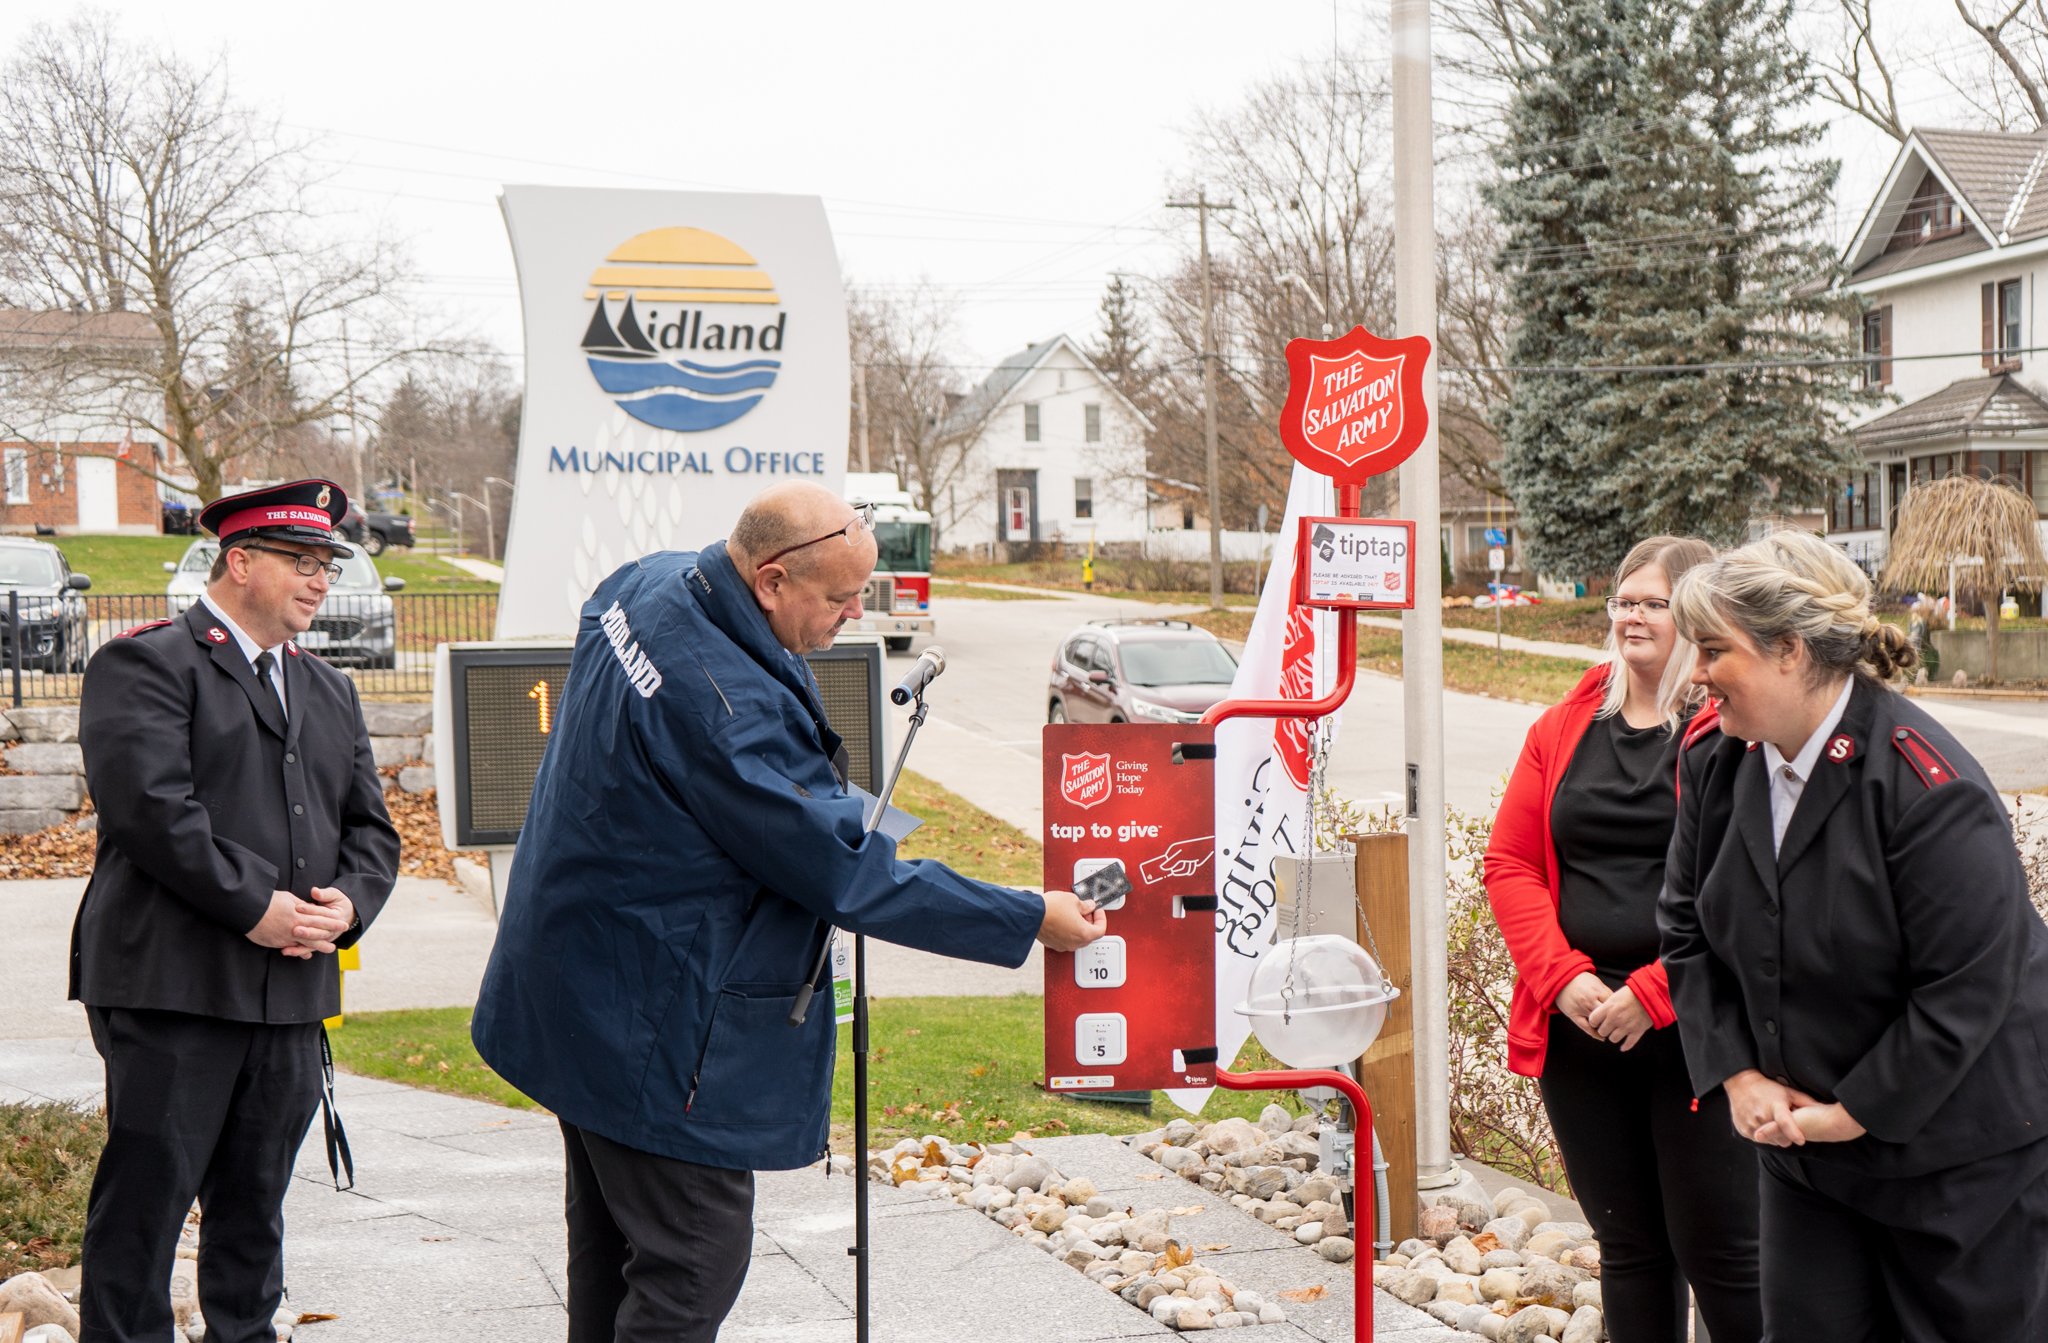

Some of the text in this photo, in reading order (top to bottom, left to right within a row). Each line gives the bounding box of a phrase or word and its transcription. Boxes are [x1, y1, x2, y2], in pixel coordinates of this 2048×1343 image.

[1323, 361, 1364, 397] THE
[1306, 369, 1396, 435] SALVATION
[1336, 402, 1393, 452] ARMY
[266, 511, 288, 519] THE
[1340, 533, 1406, 564] tiptap
[600, 600, 662, 698] MIDLAND
[528, 680, 551, 734] 1
[1829, 738, 1850, 759] S
[1071, 759, 1090, 776] THE
[1116, 761, 1148, 772] Giving
[1066, 763, 1105, 794] SALVATION
[1116, 773, 1142, 784] Hope
[1080, 778, 1105, 801] ARMY
[1116, 785, 1144, 796] Today
[1050, 823, 1086, 842] tap
[1090, 823, 1112, 838] to
[1089, 968, 1108, 980] $10
[1092, 1045, 1106, 1057] $5
